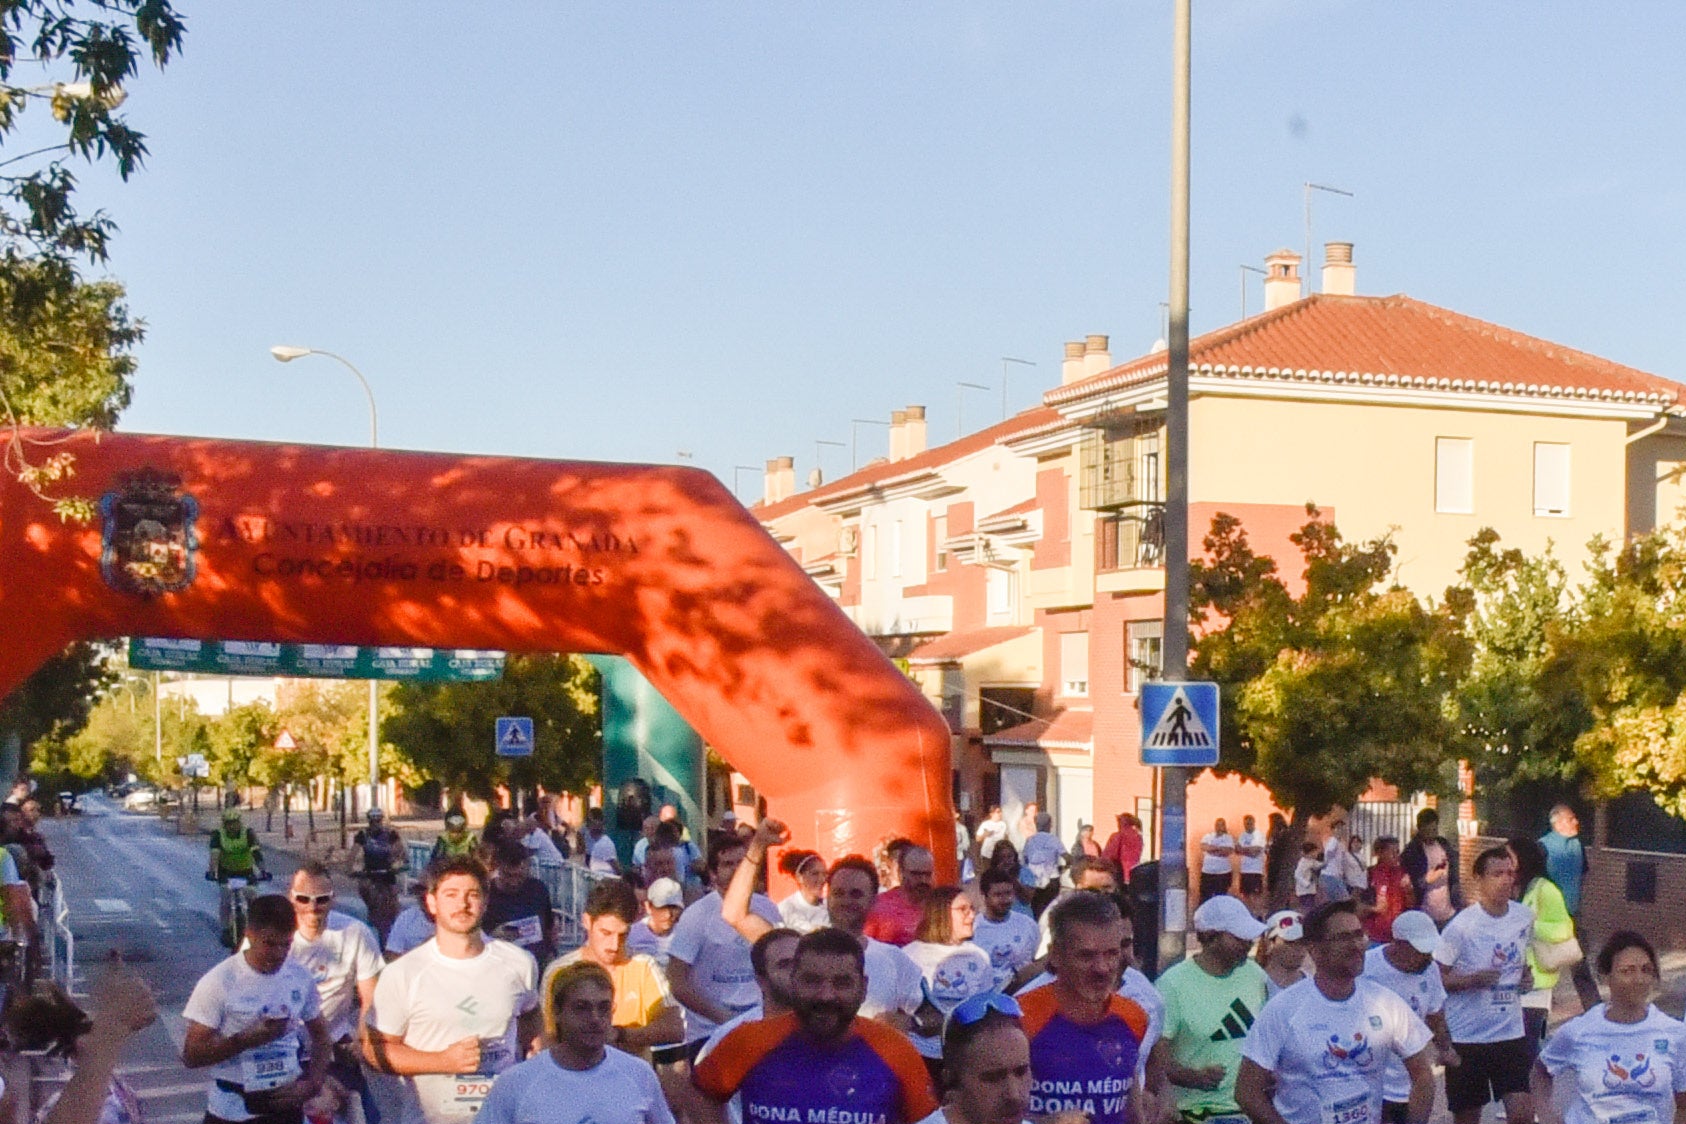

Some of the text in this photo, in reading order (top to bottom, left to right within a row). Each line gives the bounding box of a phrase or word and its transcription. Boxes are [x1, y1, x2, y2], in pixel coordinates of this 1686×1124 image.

[460, 526, 491, 549] DE
[503, 524, 640, 554] GRANADA
[427, 557, 466, 582] de
[477, 559, 604, 590] Deportes
